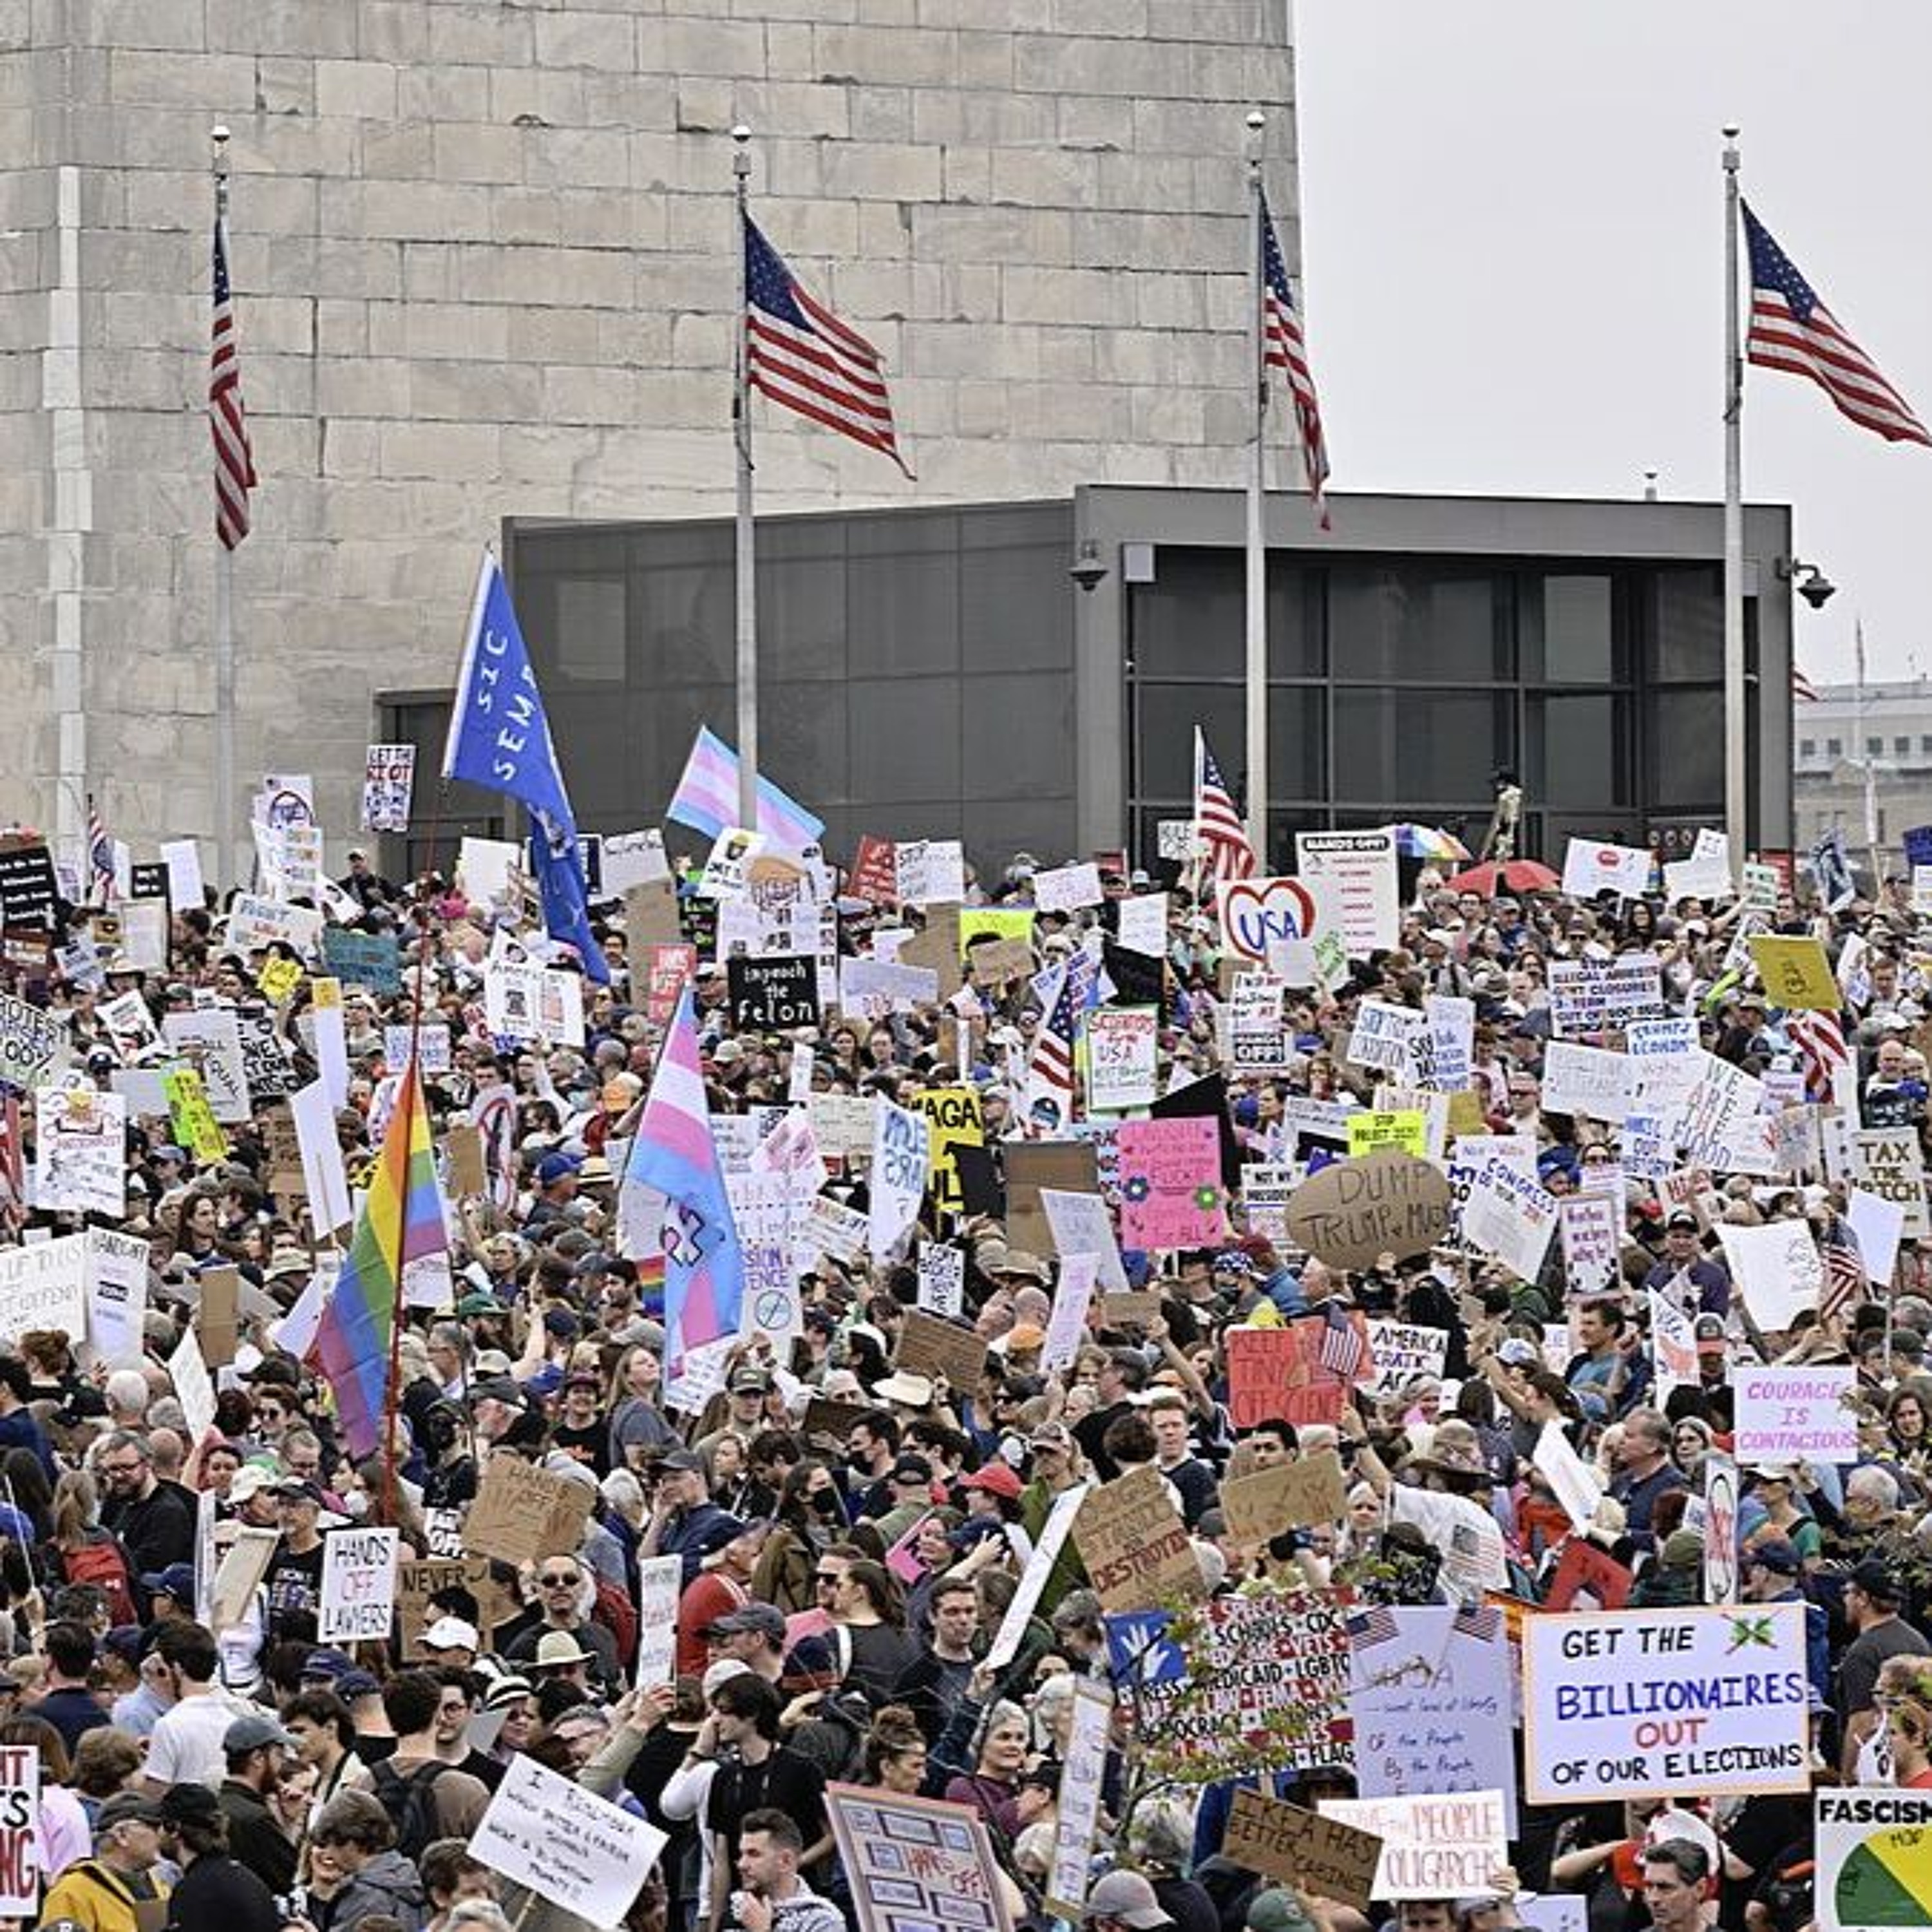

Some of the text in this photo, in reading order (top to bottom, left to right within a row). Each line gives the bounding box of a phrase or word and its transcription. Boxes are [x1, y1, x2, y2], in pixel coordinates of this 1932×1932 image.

[478, 629, 508, 714] SIC
[1240, 911, 1300, 950] USA
[763, 982, 789, 999] the
[739, 999, 815, 1024] felon
[1857, 1142, 1911, 1164] TAX
[1338, 1164, 1433, 1205] DUMP
[1869, 1166, 1904, 1179] THE
[1747, 1381, 1843, 1400] COURAGE
[1780, 1407, 1810, 1426] IS
[334, 1535, 391, 1567] HANDS
[341, 1569, 376, 1601] OFF
[401, 1565, 466, 1591] NEVER
[325, 1604, 390, 1635] LAWYERS
[1562, 1625, 1696, 1659] GET THE
[1556, 1672, 1803, 1721] BILLIONAIRES
[1634, 1718, 1709, 1749] OUT
[1551, 1743, 1803, 1785] OF OUR ELECTIONS
[1414, 1802, 1500, 1842] PEOPLE
